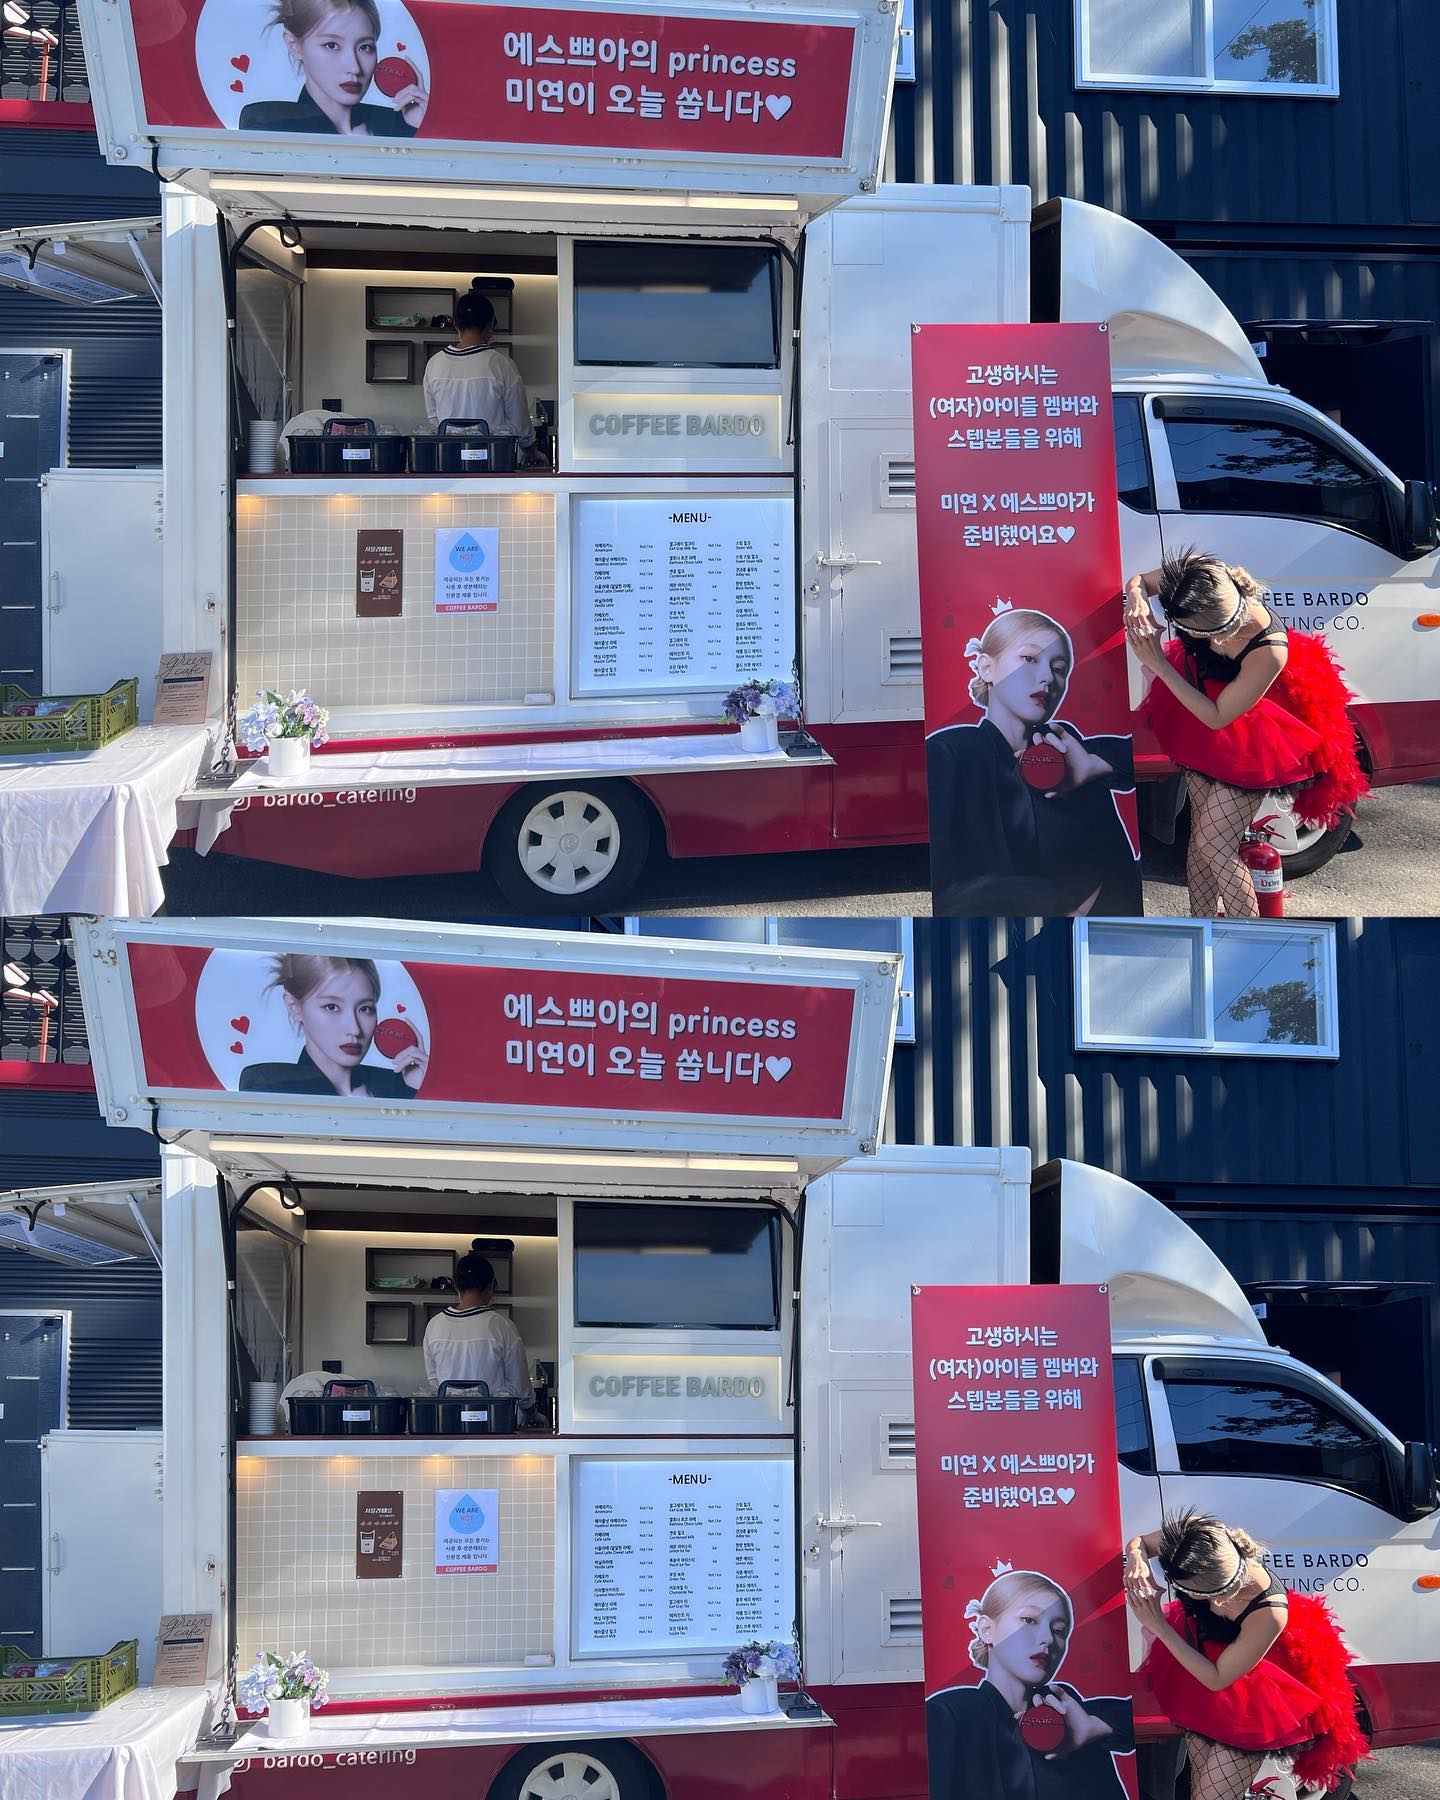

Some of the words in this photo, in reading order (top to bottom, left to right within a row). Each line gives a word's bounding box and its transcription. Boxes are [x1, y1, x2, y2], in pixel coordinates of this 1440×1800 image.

[503, 32, 658, 74] 에스쁘아의
[668, 44, 797, 79] princess
[505, 78, 595, 115] 미연이
[605, 84, 666, 120] 오늘
[675, 87, 764, 124] 씁니다
[966, 364, 1058, 386] 고생하시는
[929, 396, 1038, 419] (여자)아이들
[1043, 396, 1099, 417] 멤버와
[589, 414, 681, 436] COFFEE
[686, 415, 765, 437] BARDO
[947, 427, 1040, 451] 스텝분들을
[1045, 427, 1082, 450] 위해
[941, 493, 978, 515] 미연
[982, 494, 997, 512] X
[1000, 492, 1095, 514] 에스쁘아가
[668, 512, 712, 523] -MENU-
[962, 525, 1057, 548] 준비했어요
[1263, 592, 1296, 606] FEE
[1304, 592, 1368, 606] BARDO
[1333, 616, 1365, 630] CO.
[503, 993, 658, 1036] 에스쁘아의
[668, 1005, 797, 1040] princess
[505, 1040, 595, 1076] 미연이
[605, 1046, 666, 1081] 오늘
[675, 1049, 764, 1085] 씁니다
[966, 1326, 1058, 1348] 고생하시는
[929, 1358, 1038, 1380] (여자)아이들
[1043, 1357, 1099, 1379] 멤버와
[589, 1376, 681, 1398] COFFEE
[686, 1377, 765, 1398] BARDO
[947, 1389, 1040, 1412] 스텝분들을
[1045, 1389, 1082, 1412] 위해
[941, 1454, 978, 1476] 미연
[982, 1456, 997, 1474] X
[1000, 1454, 1095, 1476] 에스쁘아가
[668, 1474, 712, 1485] -MENU-
[962, 1487, 1057, 1509] 준비했어요
[1263, 1554, 1296, 1568] FEE
[1304, 1553, 1368, 1568] BARDO
[1333, 1577, 1365, 1592] CO.
